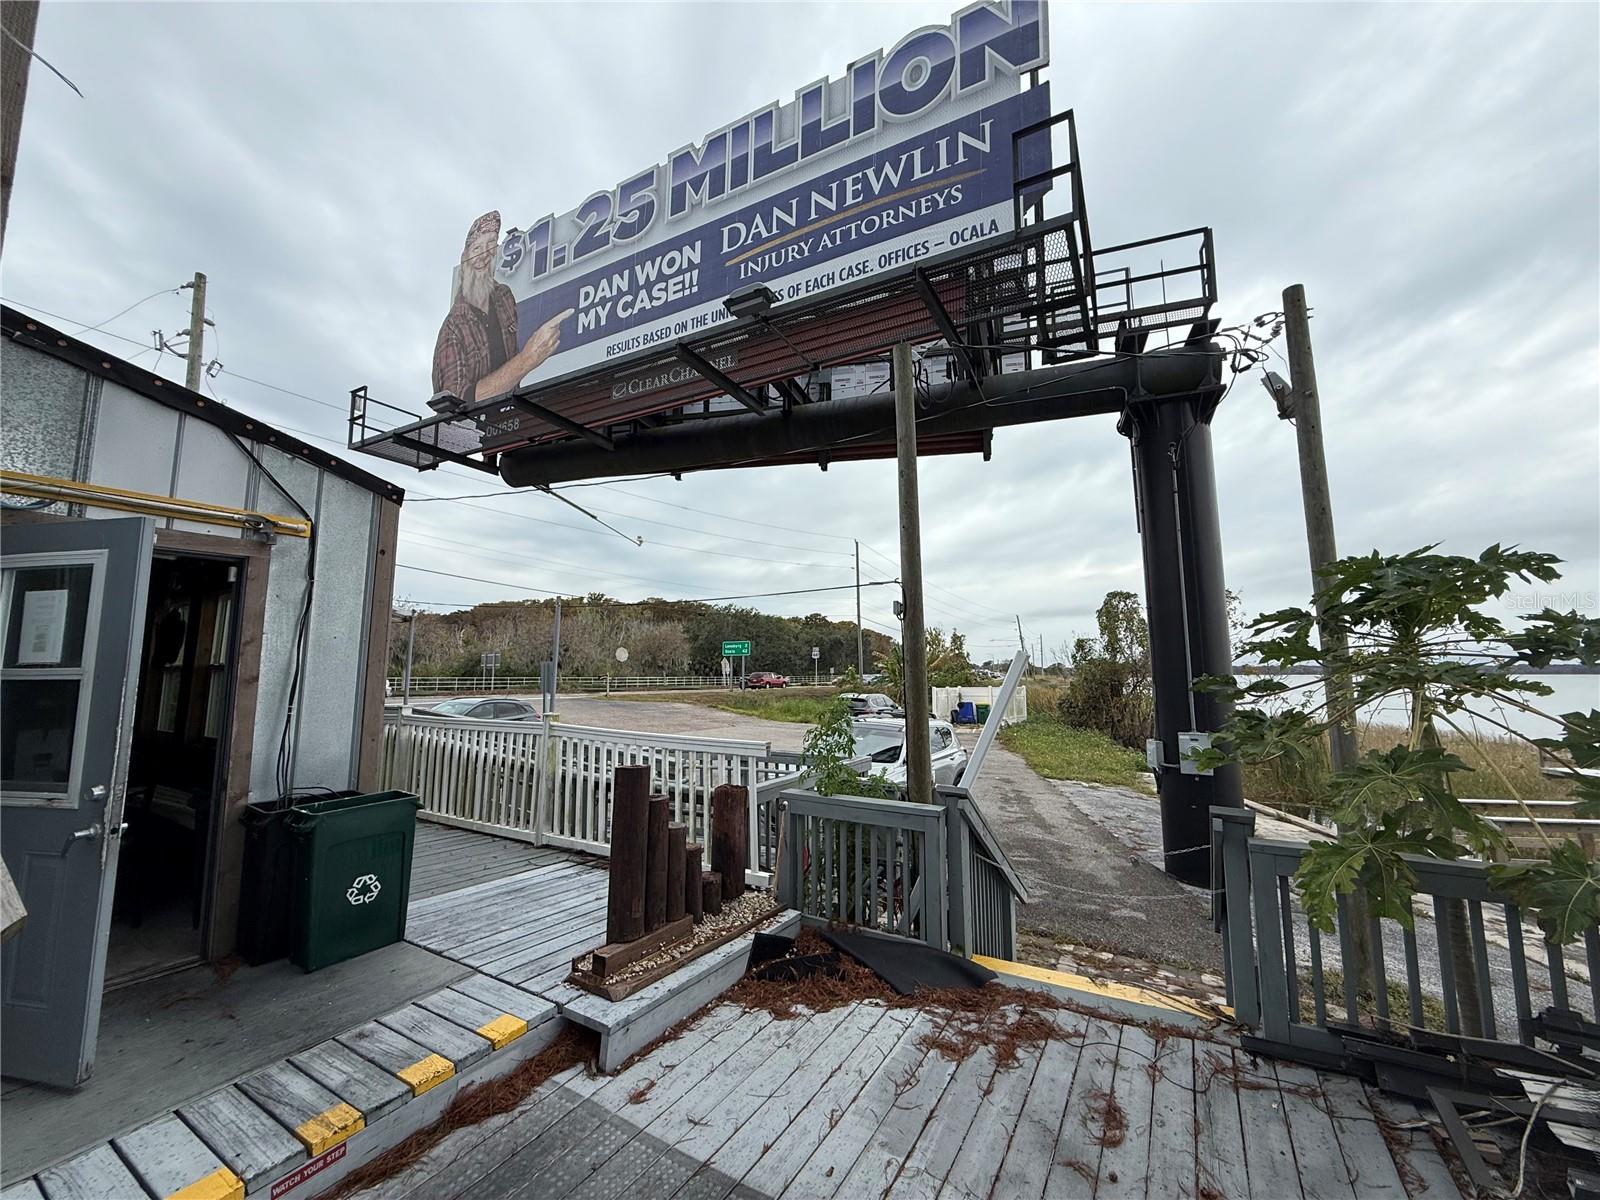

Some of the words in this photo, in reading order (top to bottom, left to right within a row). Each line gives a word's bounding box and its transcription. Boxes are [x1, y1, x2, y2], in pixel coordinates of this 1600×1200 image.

[500, 168, 658, 280] $1.25
[668, 0, 1043, 220] MILLION
[720, 198, 799, 254] DAN
[808, 119, 994, 221] NEWLIN
[579, 269, 629, 309] DAN
[634, 240, 701, 286] WON
[740, 239, 815, 279] INJURY
[817, 184, 963, 252] ATTORNEYS
[577, 301, 612, 335] MY
[616, 269, 699, 319] CASE!!
[606, 336, 641, 358] RESULTS
[642, 328, 672, 346] BASED
[674, 320, 688, 335] ON
[690, 313, 708, 330] THE
[787, 283, 803, 299] OF
[805, 271, 836, 293] EACH
[839, 259, 874, 282] CASE.
[878, 240, 930, 269] OFFICES
[949, 219, 1000, 246] OCALA
[272, 1174, 301, 1197] WATCH
[303, 1160, 324, 1178] YOUR
[326, 1146, 346, 1163] STEP
